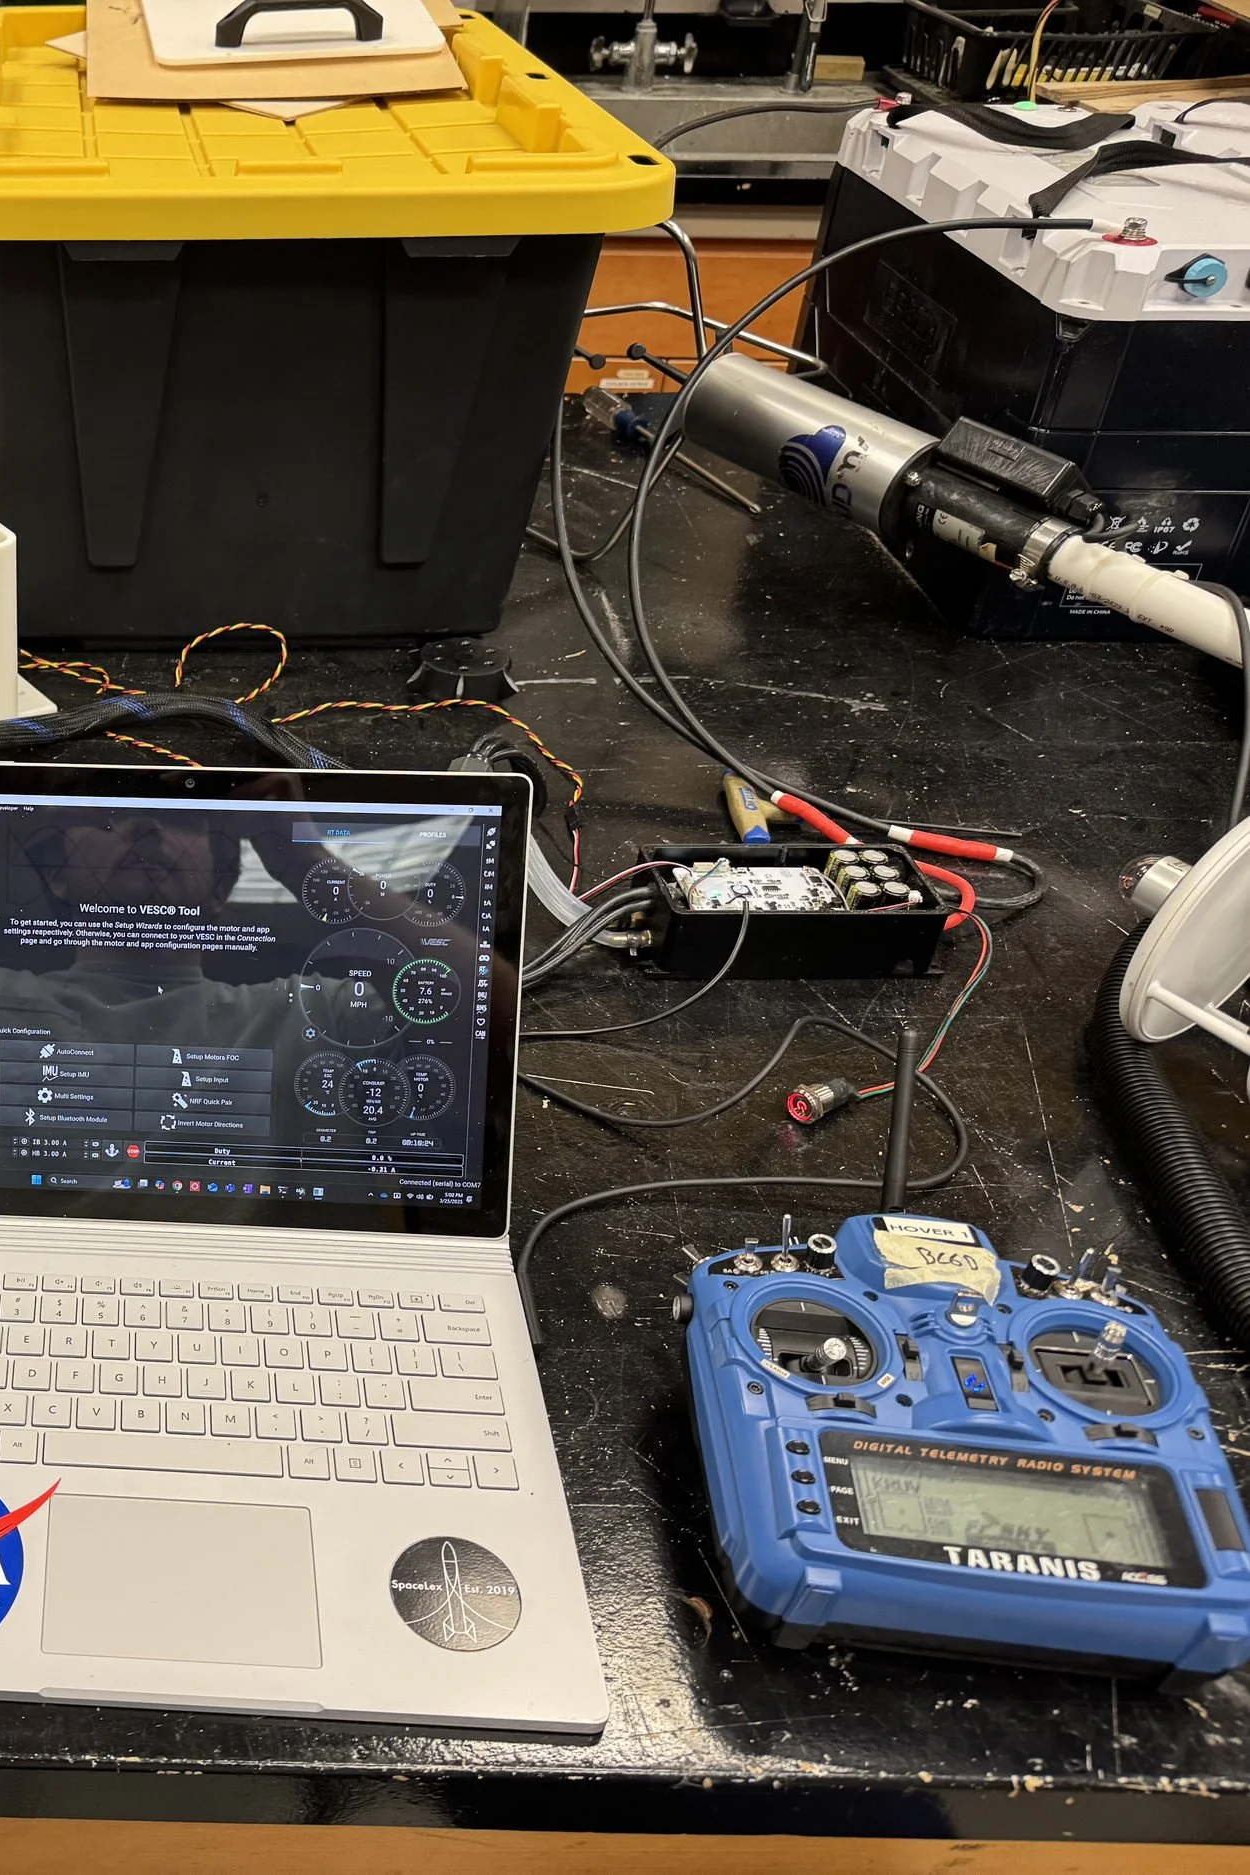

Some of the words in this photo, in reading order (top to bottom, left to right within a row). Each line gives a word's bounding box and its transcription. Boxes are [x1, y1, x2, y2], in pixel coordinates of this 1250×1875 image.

[80, 903, 124, 914] Welcome
[127, 905, 137, 914] to
[178, 906, 200, 916] Tool
[33, 919, 59, 927] started,
[114, 922, 134, 930] Setup
[136, 922, 163, 930] Wizards
[173, 924, 205, 932] configure
[206, 924, 218, 932] the
[3, 928, 30, 936] settings
[32, 929, 74, 937] respectively.
[76, 929, 112, 938] Otherwise,
[224, 934, 235, 942] the
[237, 935, 276, 943] Connection
[63, 938, 90, 947] through
[155, 942, 200, 950] configuration
[225, 944, 258, 952] manually.
[354, 981, 365, 996] 0
[419, 987, 432, 995] 7.6
[42, 1065, 58, 1076] IMU
[322, 1080, 334, 1088] 24
[70, 1093, 94, 1101] Settings
[365, 1088, 382, 1097] -12
[363, 1106, 383, 1115] 20.4
[40, 1114, 56, 1122] Setup
[214, 1147, 231, 1156] Duty
[208, 1158, 236, 1167] Current
[399, 1178, 431, 1187] Connected
[890, 1224, 955, 1237] HOVER
[447, 1325, 481, 1333] Backspace
[823, 1455, 849, 1465] MENU
[853, 1440, 913, 1456] DIGITAL
[920, 1447, 1010, 1466] TELEMETRY
[1016, 1458, 1065, 1473] RADIO
[1070, 1464, 1137, 1481] SYSTEM
[830, 1485, 854, 1495] PAGE
[836, 1515, 861, 1526] EXIT
[943, 1545, 1101, 1582] TARANIS
[391, 1579, 443, 1592] SpaceLex
[464, 1584, 484, 1595] Est.
[486, 1586, 516, 1596] 2019
